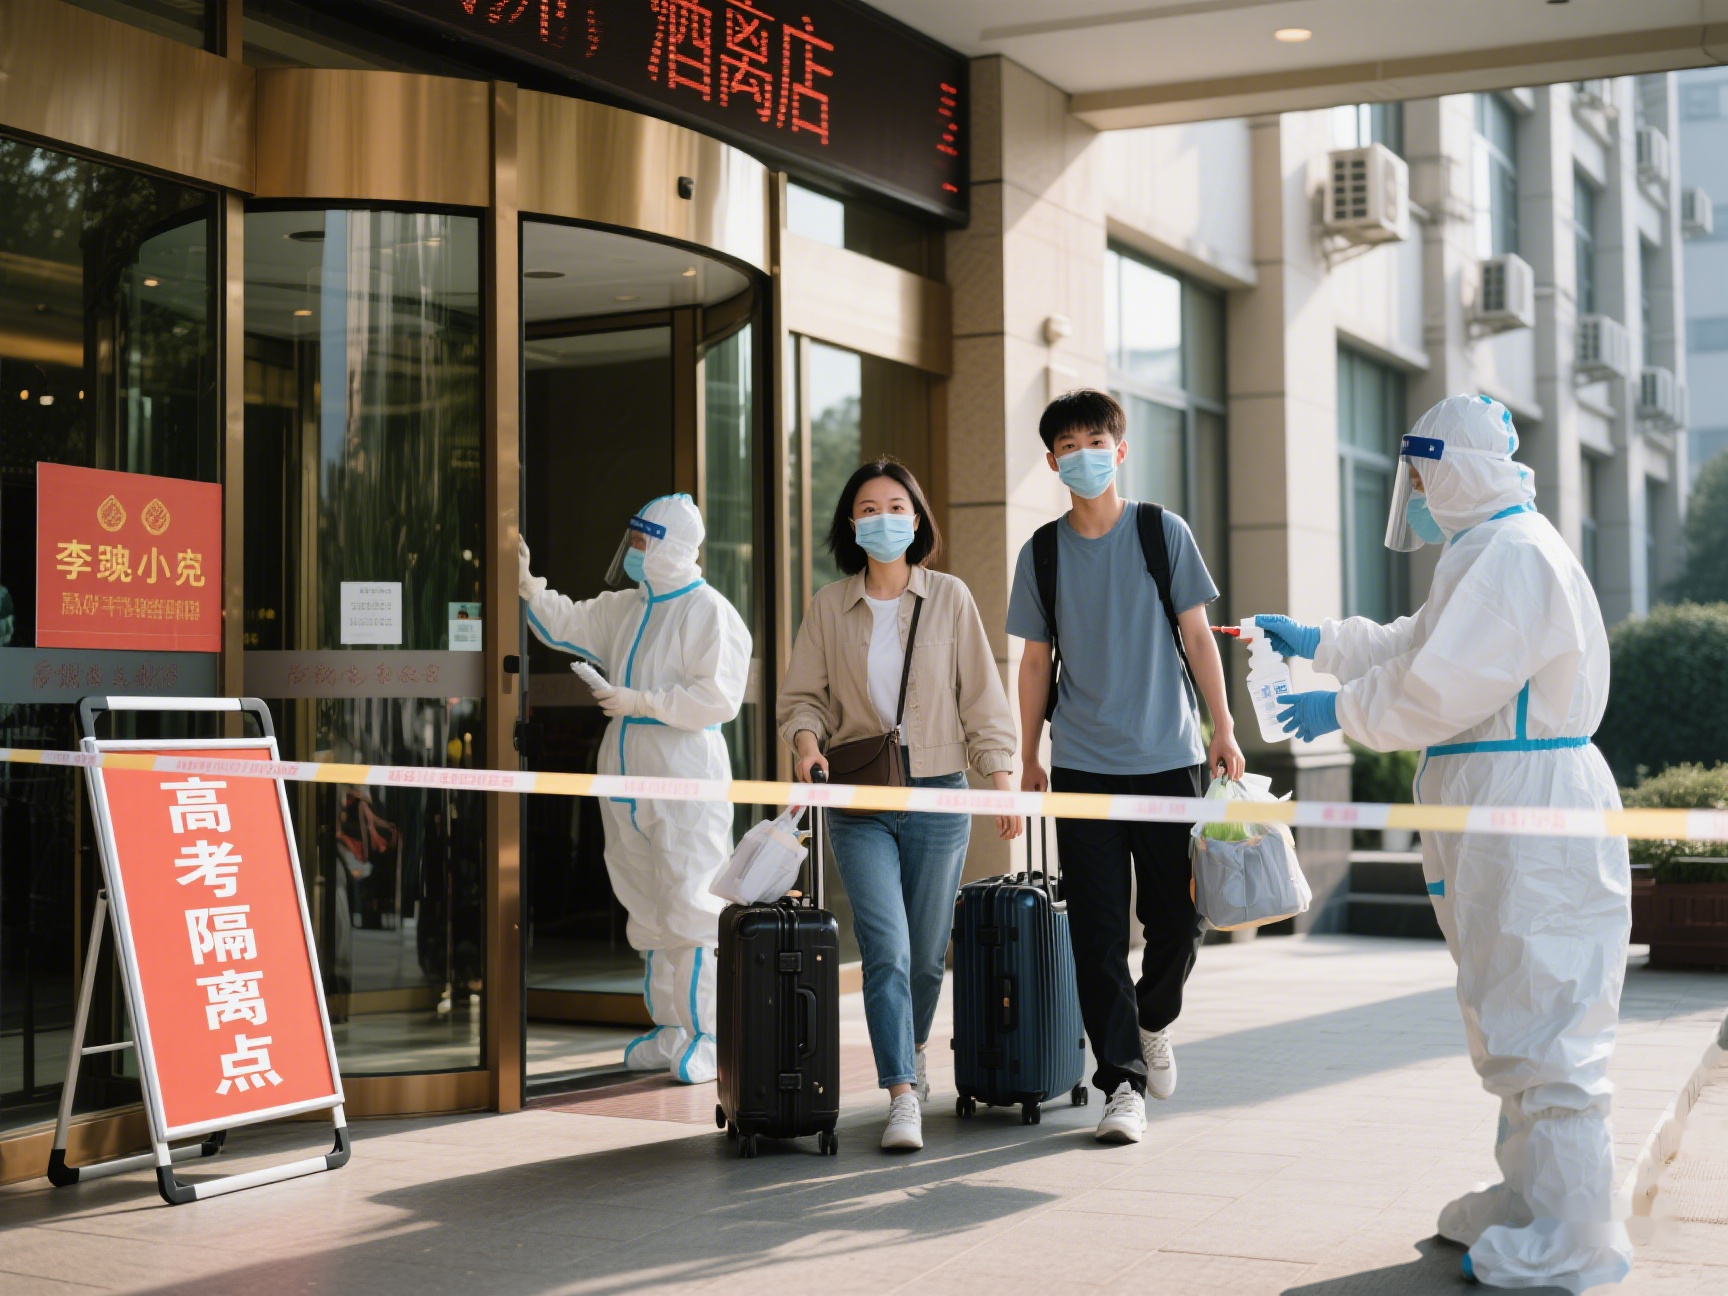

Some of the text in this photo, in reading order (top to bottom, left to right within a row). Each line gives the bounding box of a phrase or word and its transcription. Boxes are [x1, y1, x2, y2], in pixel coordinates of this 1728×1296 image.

[160, 776, 283, 1096] 高考隔离点
